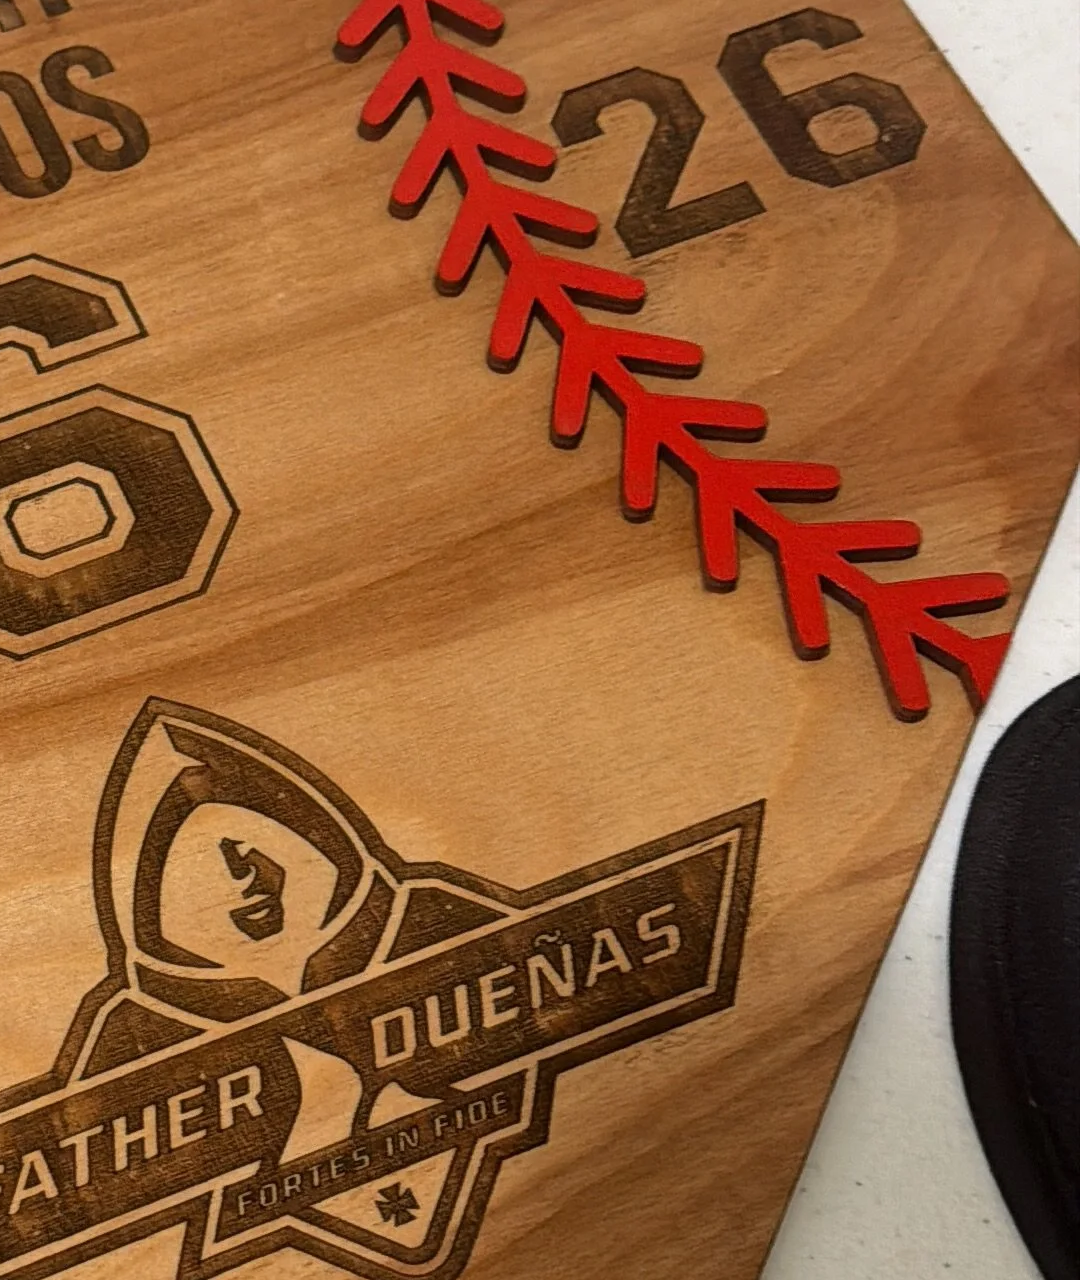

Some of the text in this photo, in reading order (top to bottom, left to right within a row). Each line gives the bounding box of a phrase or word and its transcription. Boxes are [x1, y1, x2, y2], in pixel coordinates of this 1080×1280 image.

[550, 7, 928, 259] 26
[370, 902, 681, 1070] DUEÑAS
[237, 1090, 508, 1216] FORTES IN FIDE
